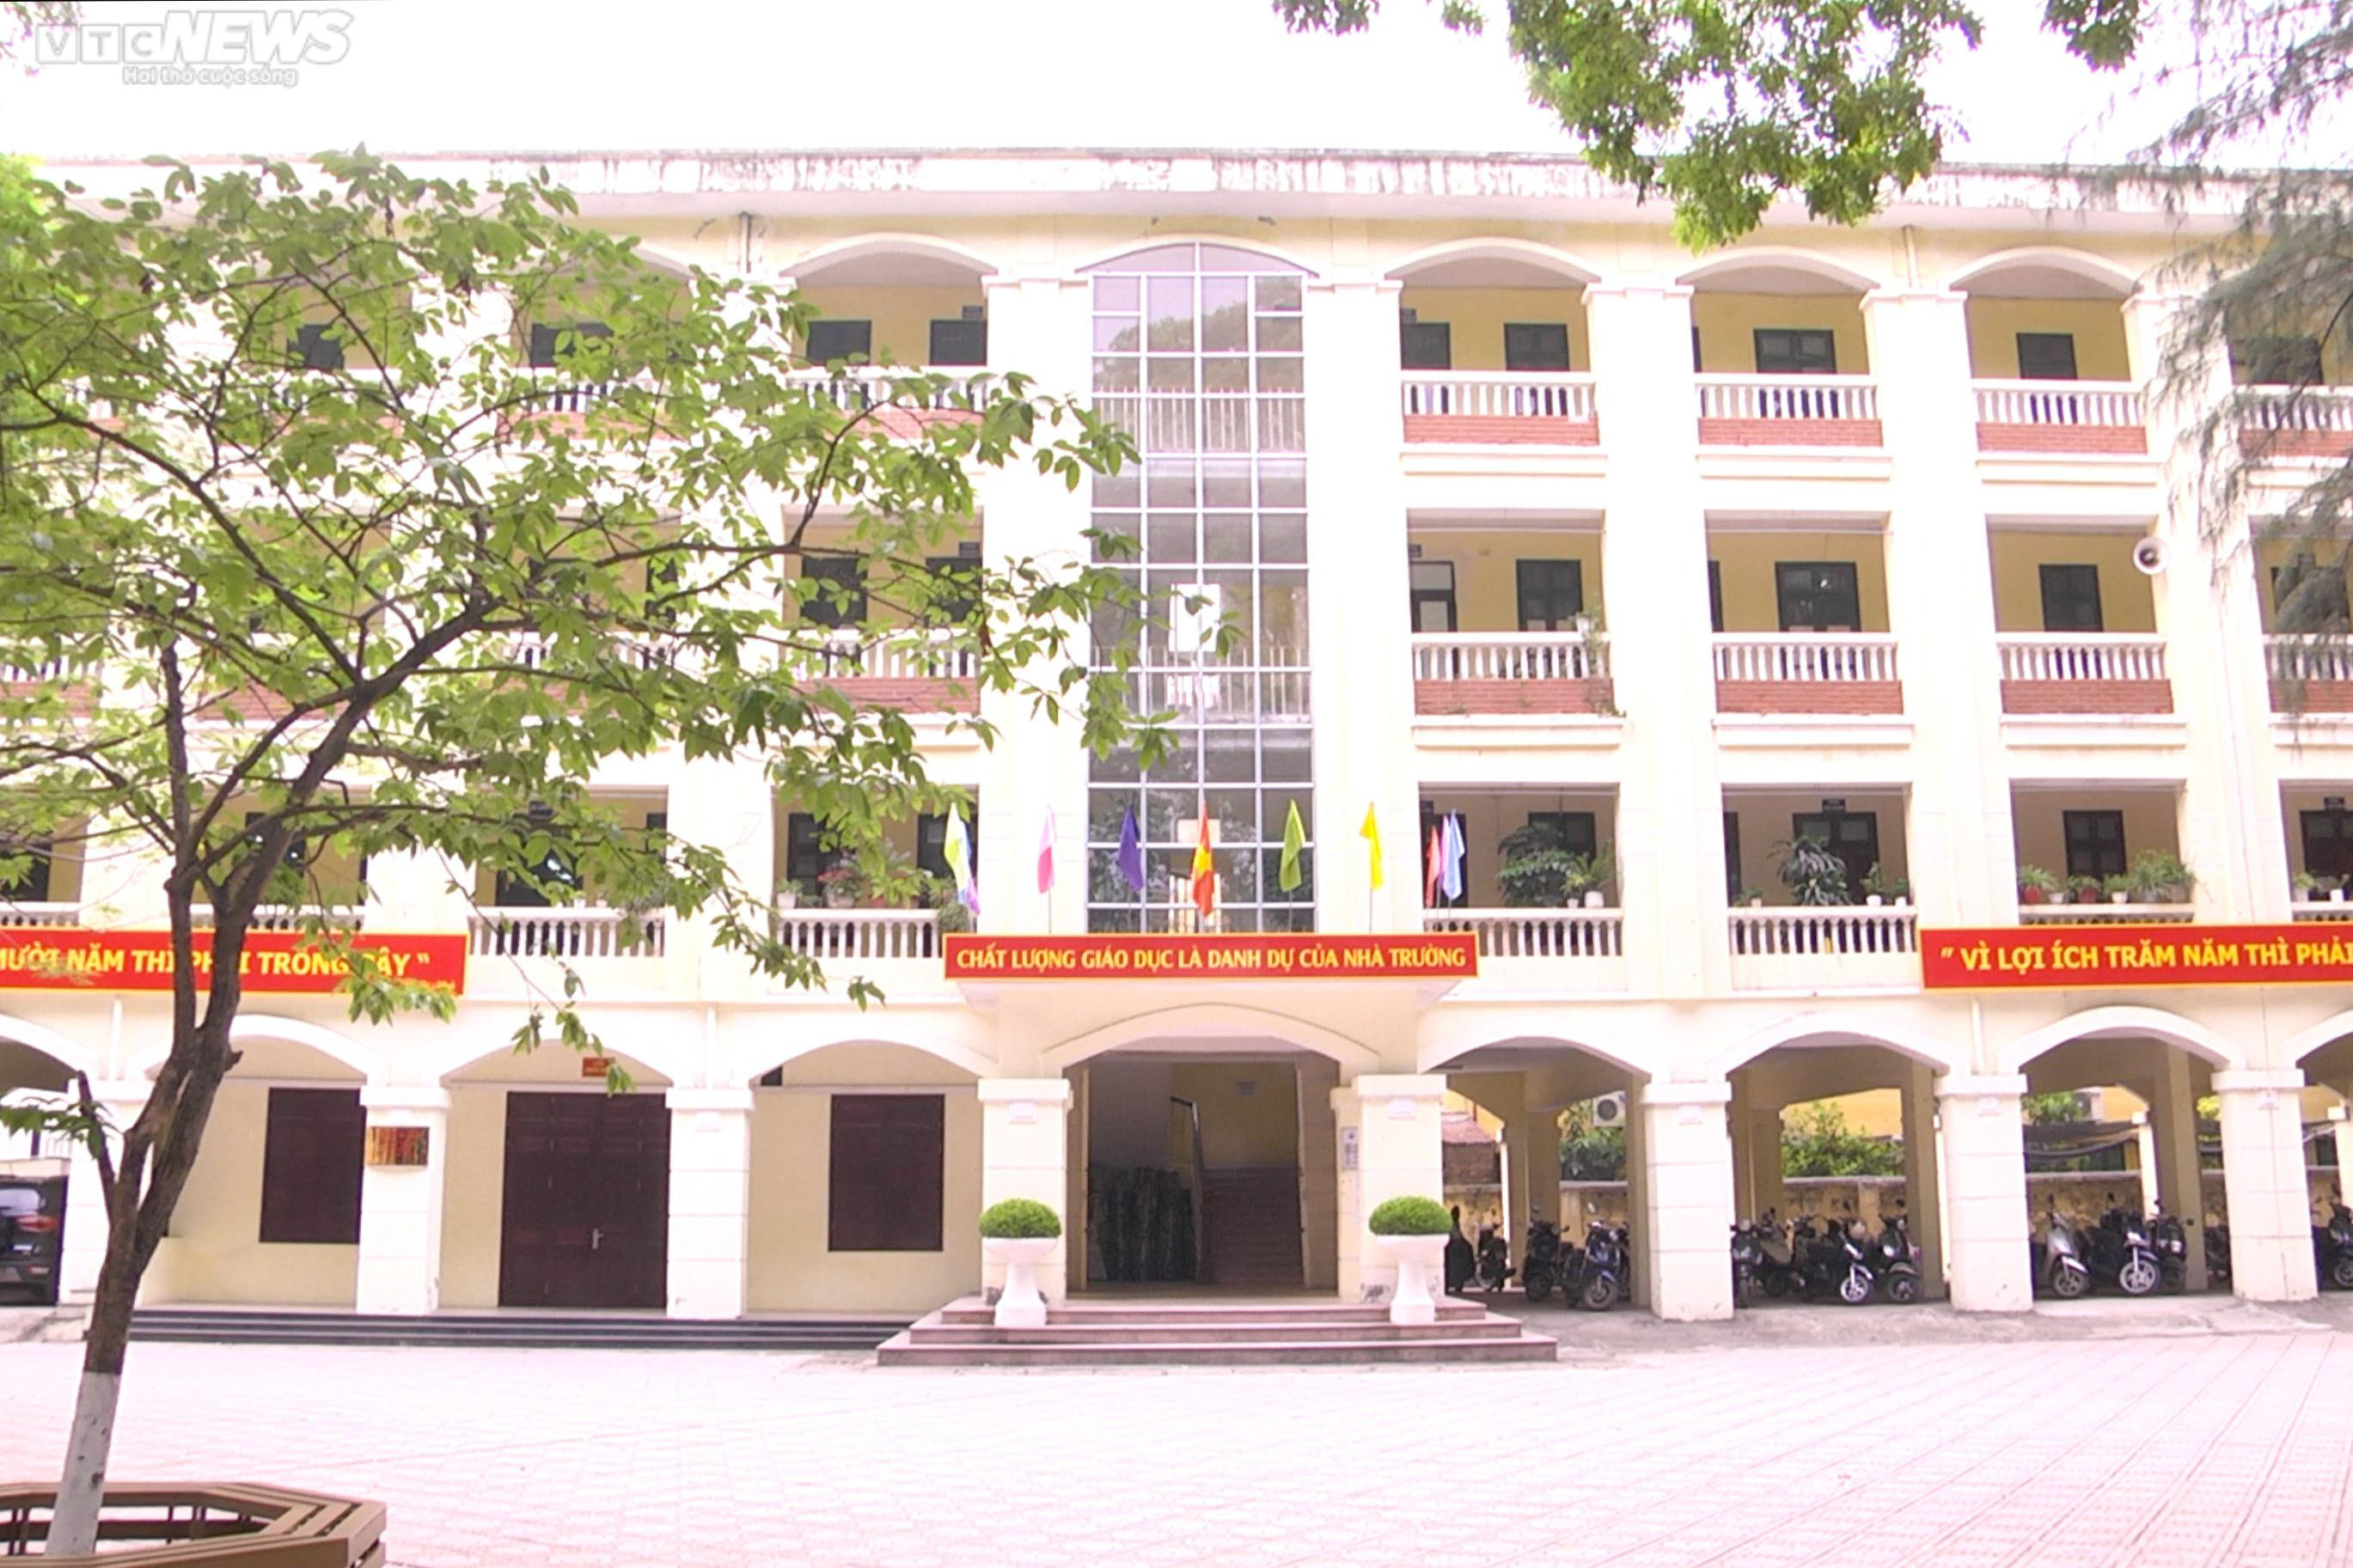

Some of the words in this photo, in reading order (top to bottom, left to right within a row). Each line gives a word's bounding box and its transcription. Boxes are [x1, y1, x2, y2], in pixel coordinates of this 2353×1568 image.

[66, 943, 125, 973] NĂM
[956, 943, 1007, 968] CHẤT
[1011, 948, 1076, 973] LƯỢNG
[1081, 943, 1128, 968] GIÁO
[1134, 949, 1174, 973] DỤC
[1178, 944, 1202, 968] LÀ
[1207, 949, 1262, 968] DANH
[1267, 948, 1295, 973] DỰ
[1299, 943, 1339, 968] CỦA
[1343, 943, 1384, 967] NHÀ
[1389, 943, 1466, 967] TRƯỜNG
[1960, 940, 1991, 970] VÌ
[1998, 947, 2045, 974] LỢI
[2051, 939, 2099, 969] ÍCH
[2104, 938, 2177, 968] TRĂM
[2183, 937, 2240, 967] NĂM
[2244, 936, 2290, 966] THÌ
